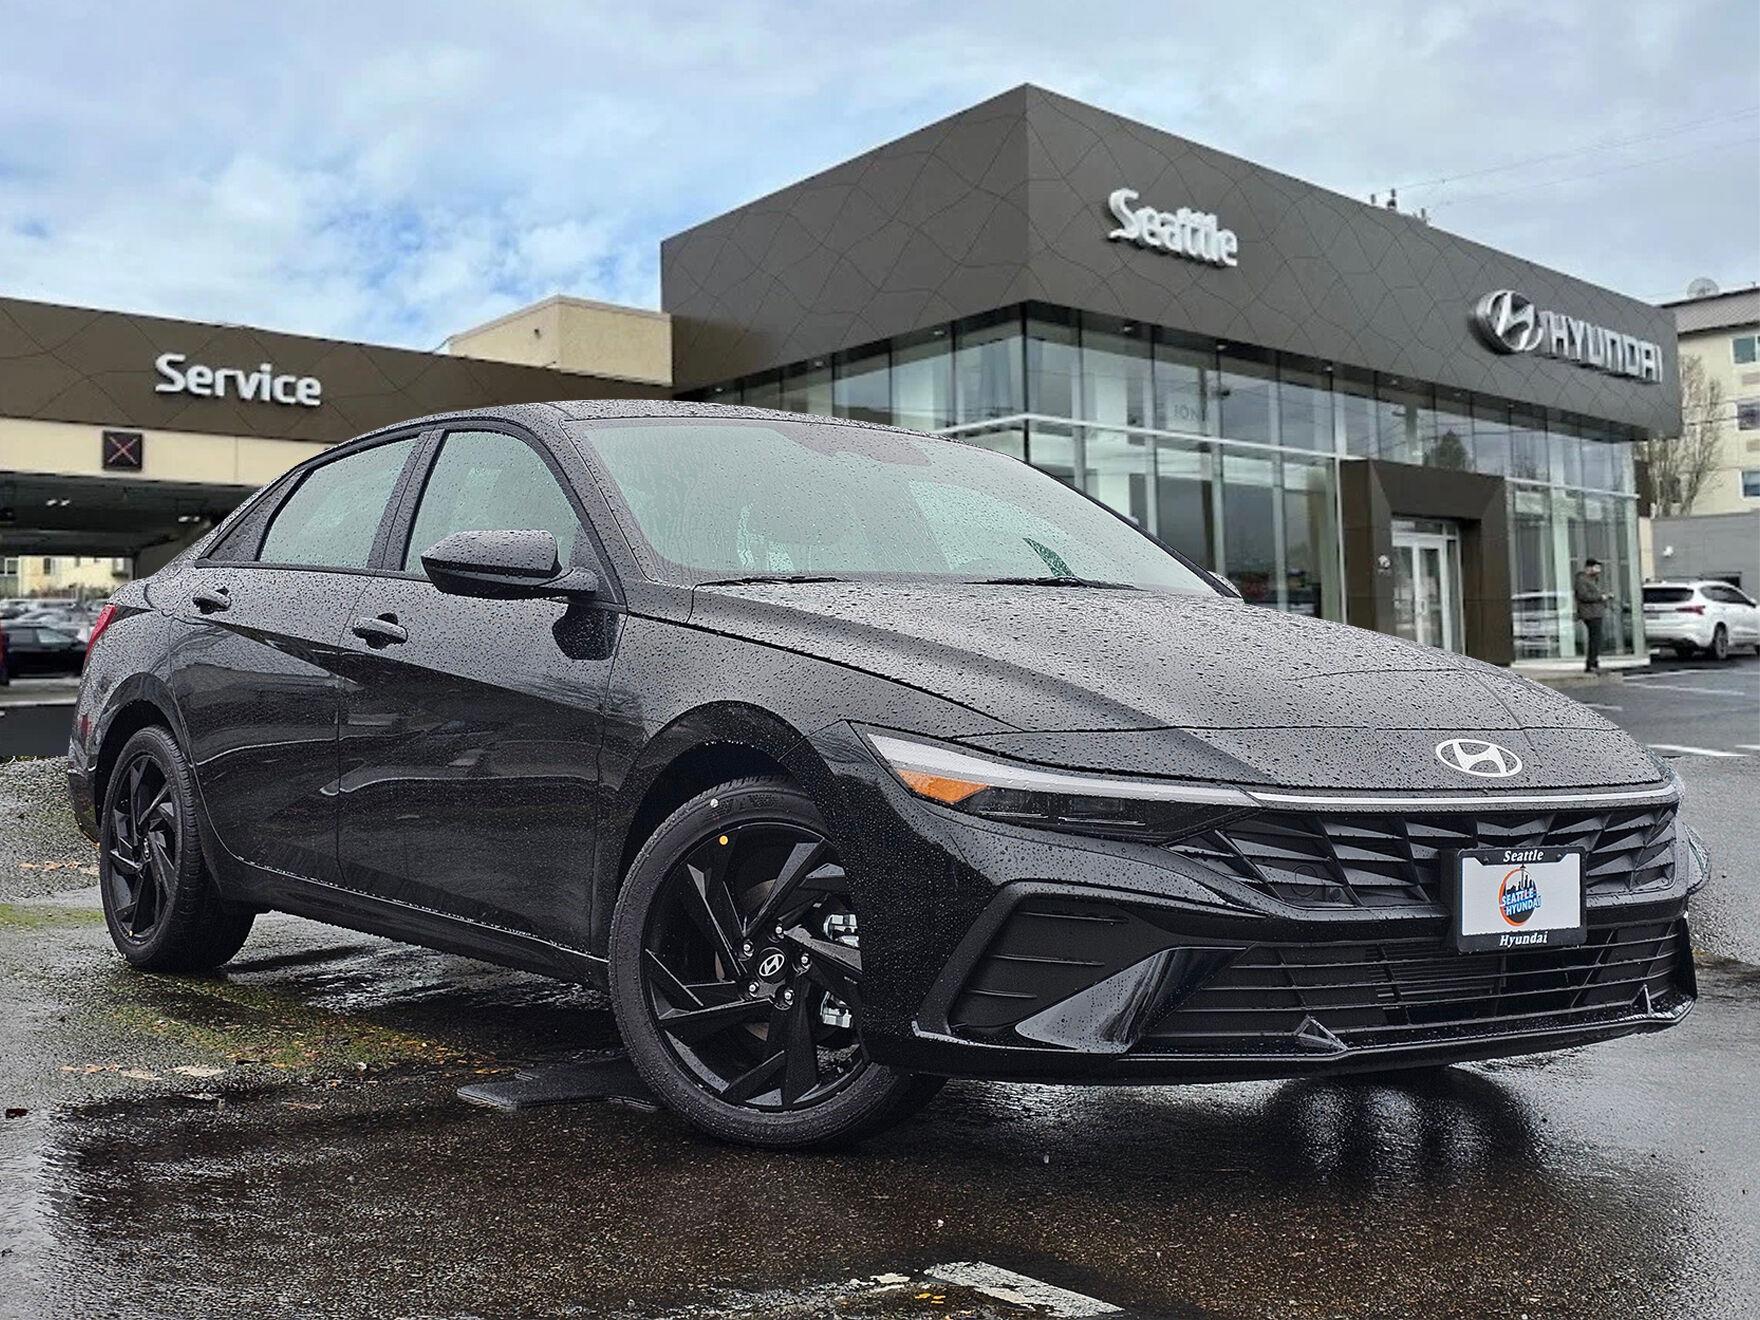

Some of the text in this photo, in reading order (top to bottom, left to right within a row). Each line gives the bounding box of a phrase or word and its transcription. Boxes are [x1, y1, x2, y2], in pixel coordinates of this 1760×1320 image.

[1108, 188, 1238, 267] Seattle
[1546, 311, 1663, 383] HYUNDAI
[155, 352, 322, 407] Service
[1503, 849, 1544, 863] Seattle
[1501, 888, 1536, 907] SEATTLE
[1506, 896, 1542, 916] HYUNDAI
[1499, 931, 1548, 948] Hyundai
